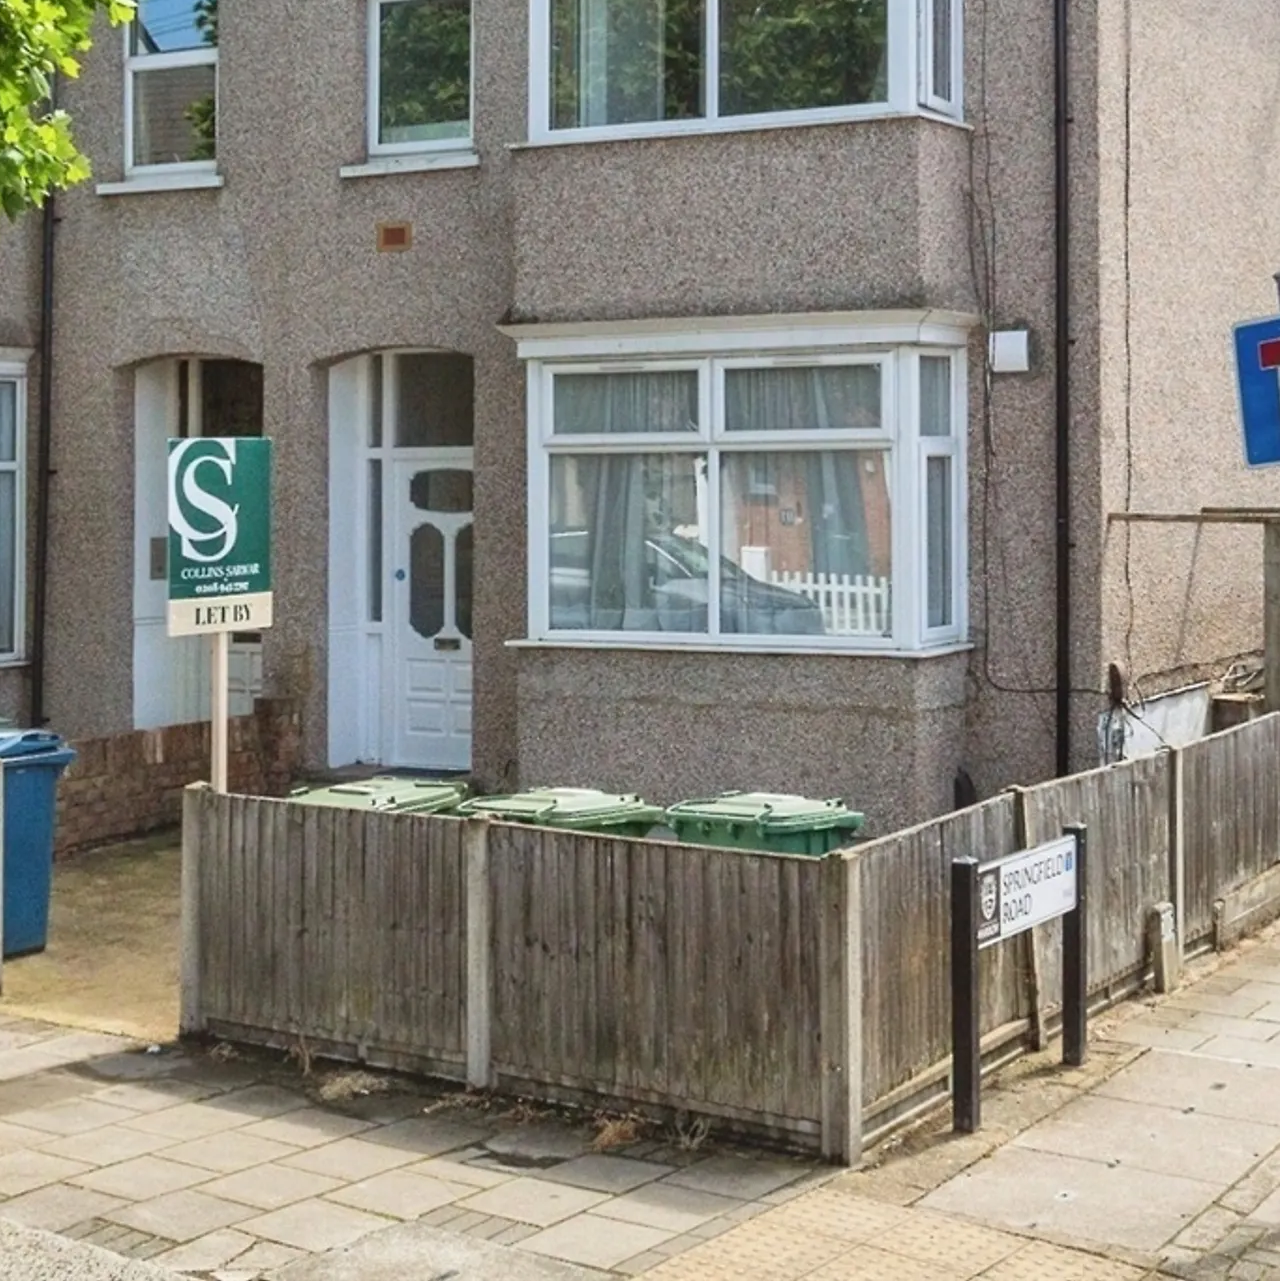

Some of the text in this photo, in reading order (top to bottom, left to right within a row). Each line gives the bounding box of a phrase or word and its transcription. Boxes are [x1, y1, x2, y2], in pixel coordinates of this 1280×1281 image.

[180, 566, 225, 580] COLLINS
[195, 602, 253, 625] LET BY
[1002, 853, 1063, 896] SPRINGFIELD
[1002, 893, 1032, 924] ROAD
